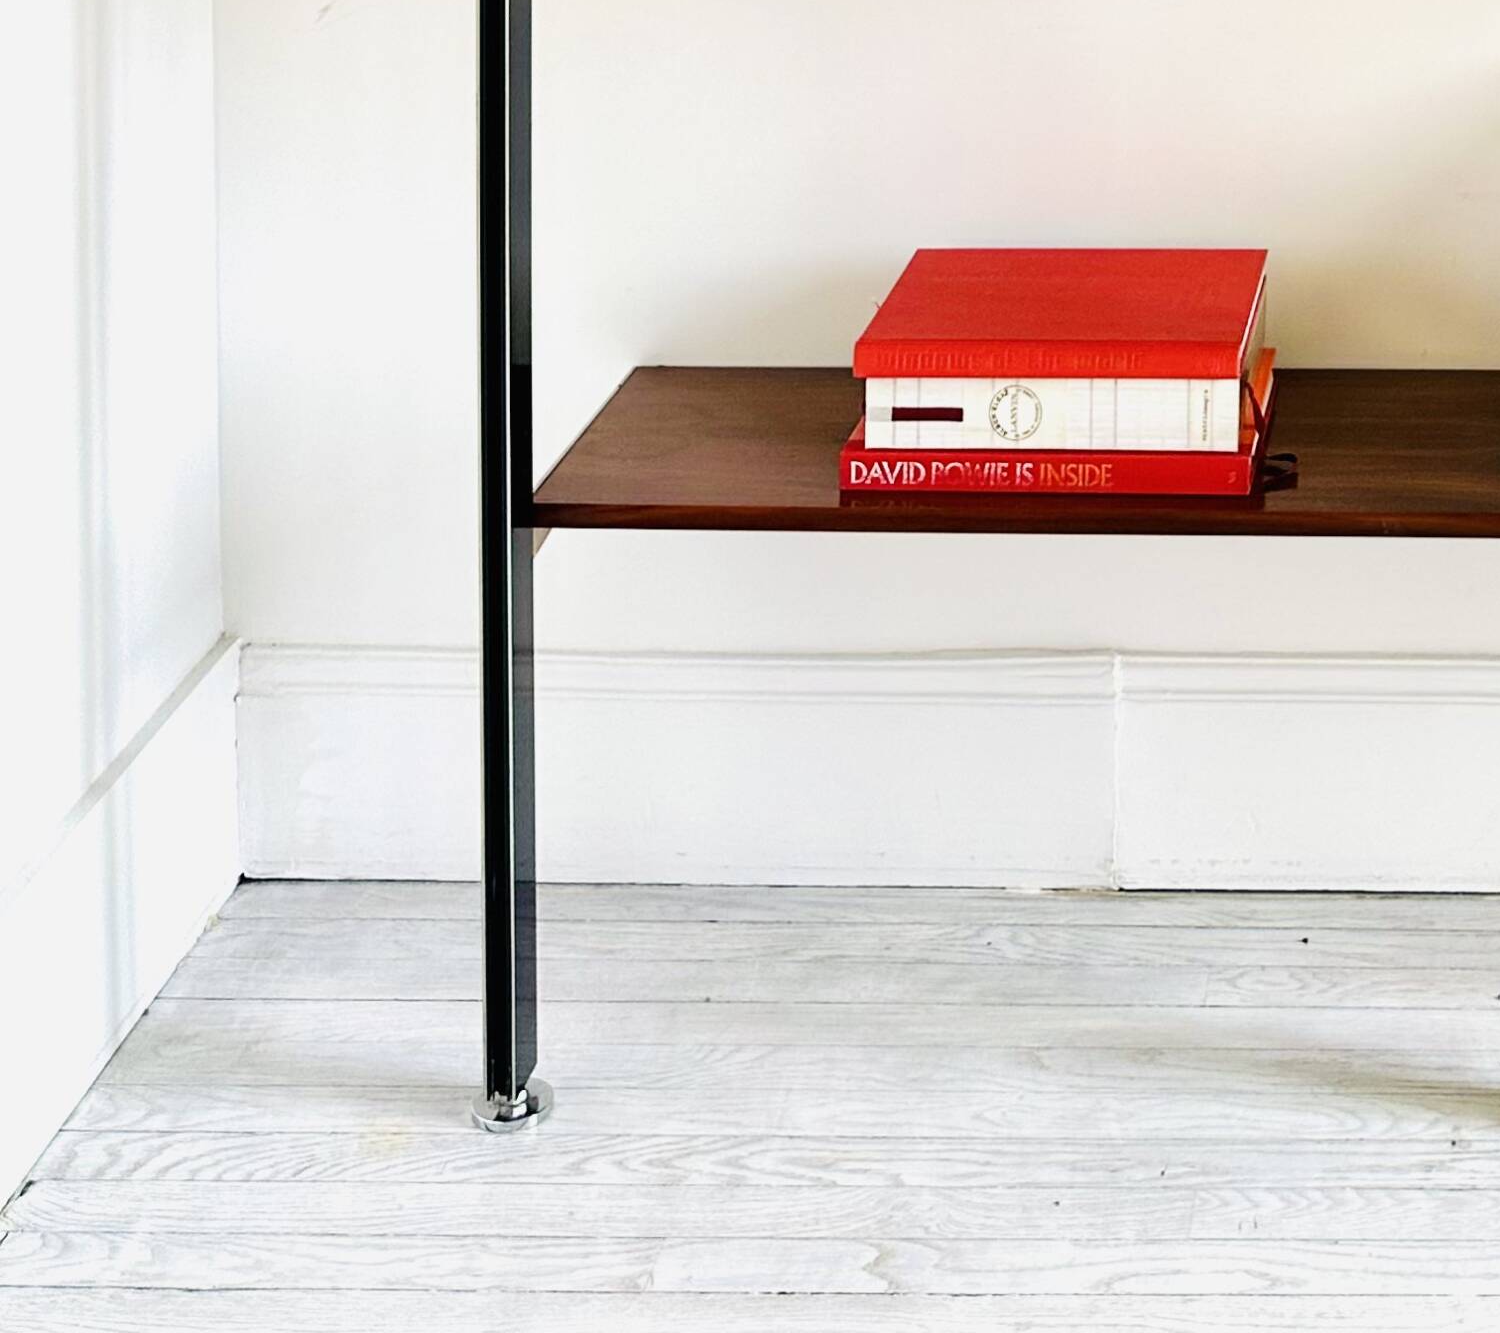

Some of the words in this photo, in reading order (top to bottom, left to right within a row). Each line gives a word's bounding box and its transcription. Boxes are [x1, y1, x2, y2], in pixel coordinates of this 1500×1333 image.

[850, 460, 926, 485] DAVID
[1015, 462, 1034, 485] IS
[1039, 462, 1114, 487] INSIDE
